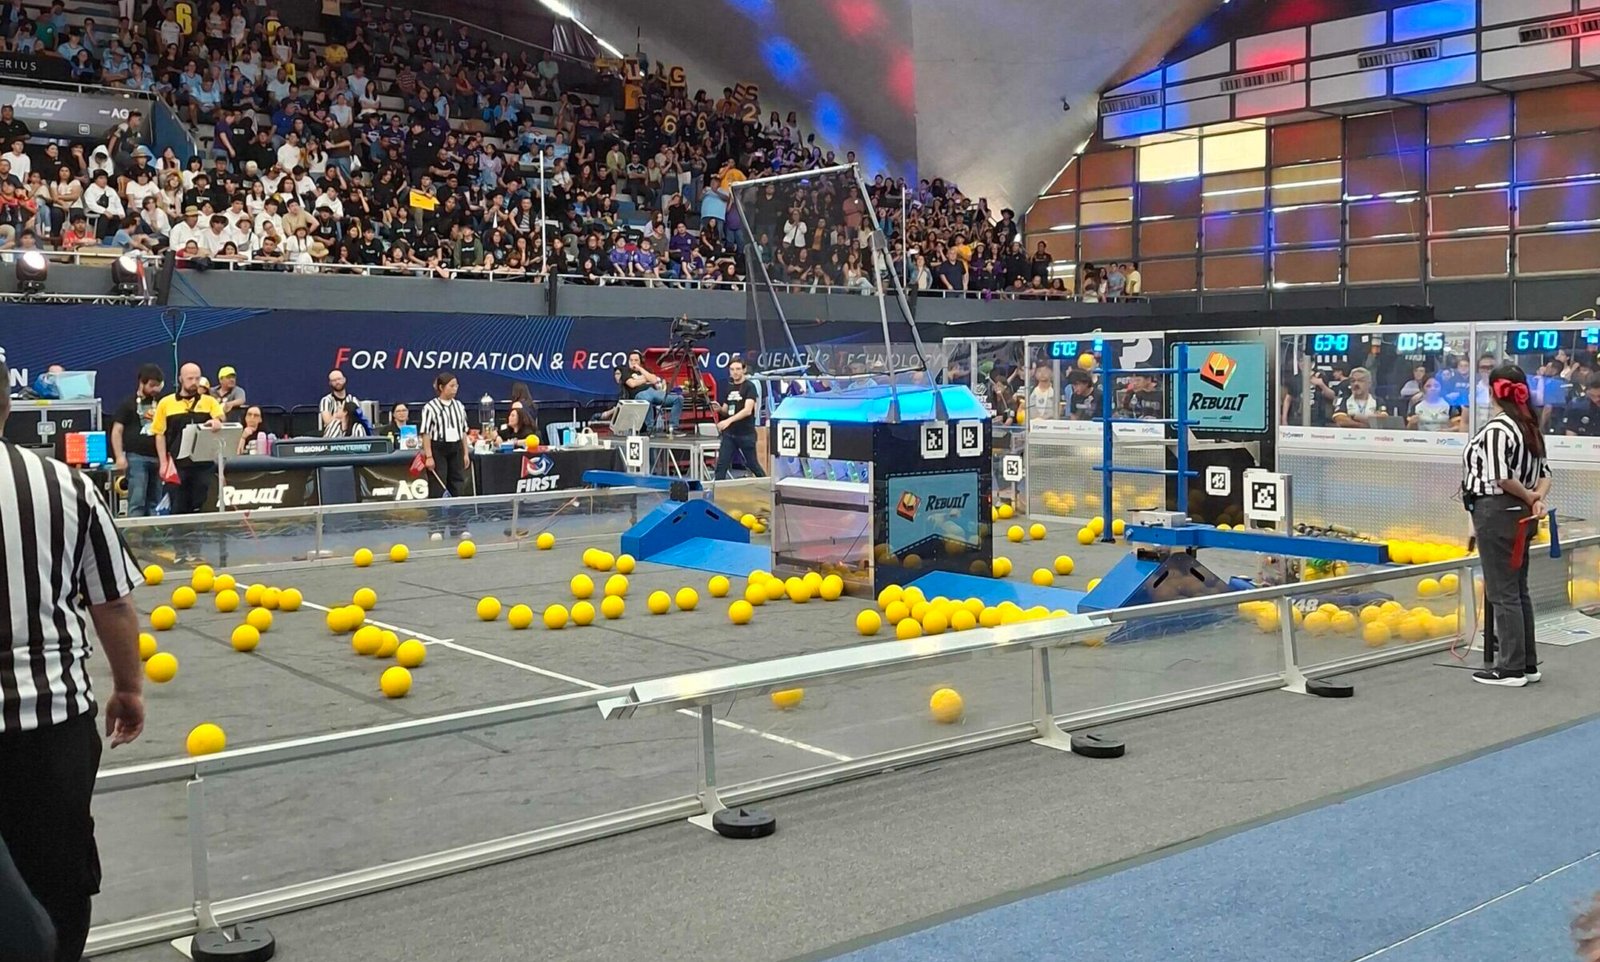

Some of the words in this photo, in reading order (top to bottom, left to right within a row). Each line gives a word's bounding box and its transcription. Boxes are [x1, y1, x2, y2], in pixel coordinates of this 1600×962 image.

[13, 93, 68, 111] REBUILT
[1052, 341, 1077, 356] 6702
[1315, 334, 1348, 351] 6348
[1517, 331, 1558, 350] 6170
[335, 348, 388, 370] FOR
[395, 348, 543, 371] INSPIRATION
[550, 352, 563, 370] &
[1189, 392, 1249, 412] REBUILT
[62, 419, 73, 429] 07
[516, 475, 560, 494] FIRST
[925, 493, 971, 512] REBUILT
